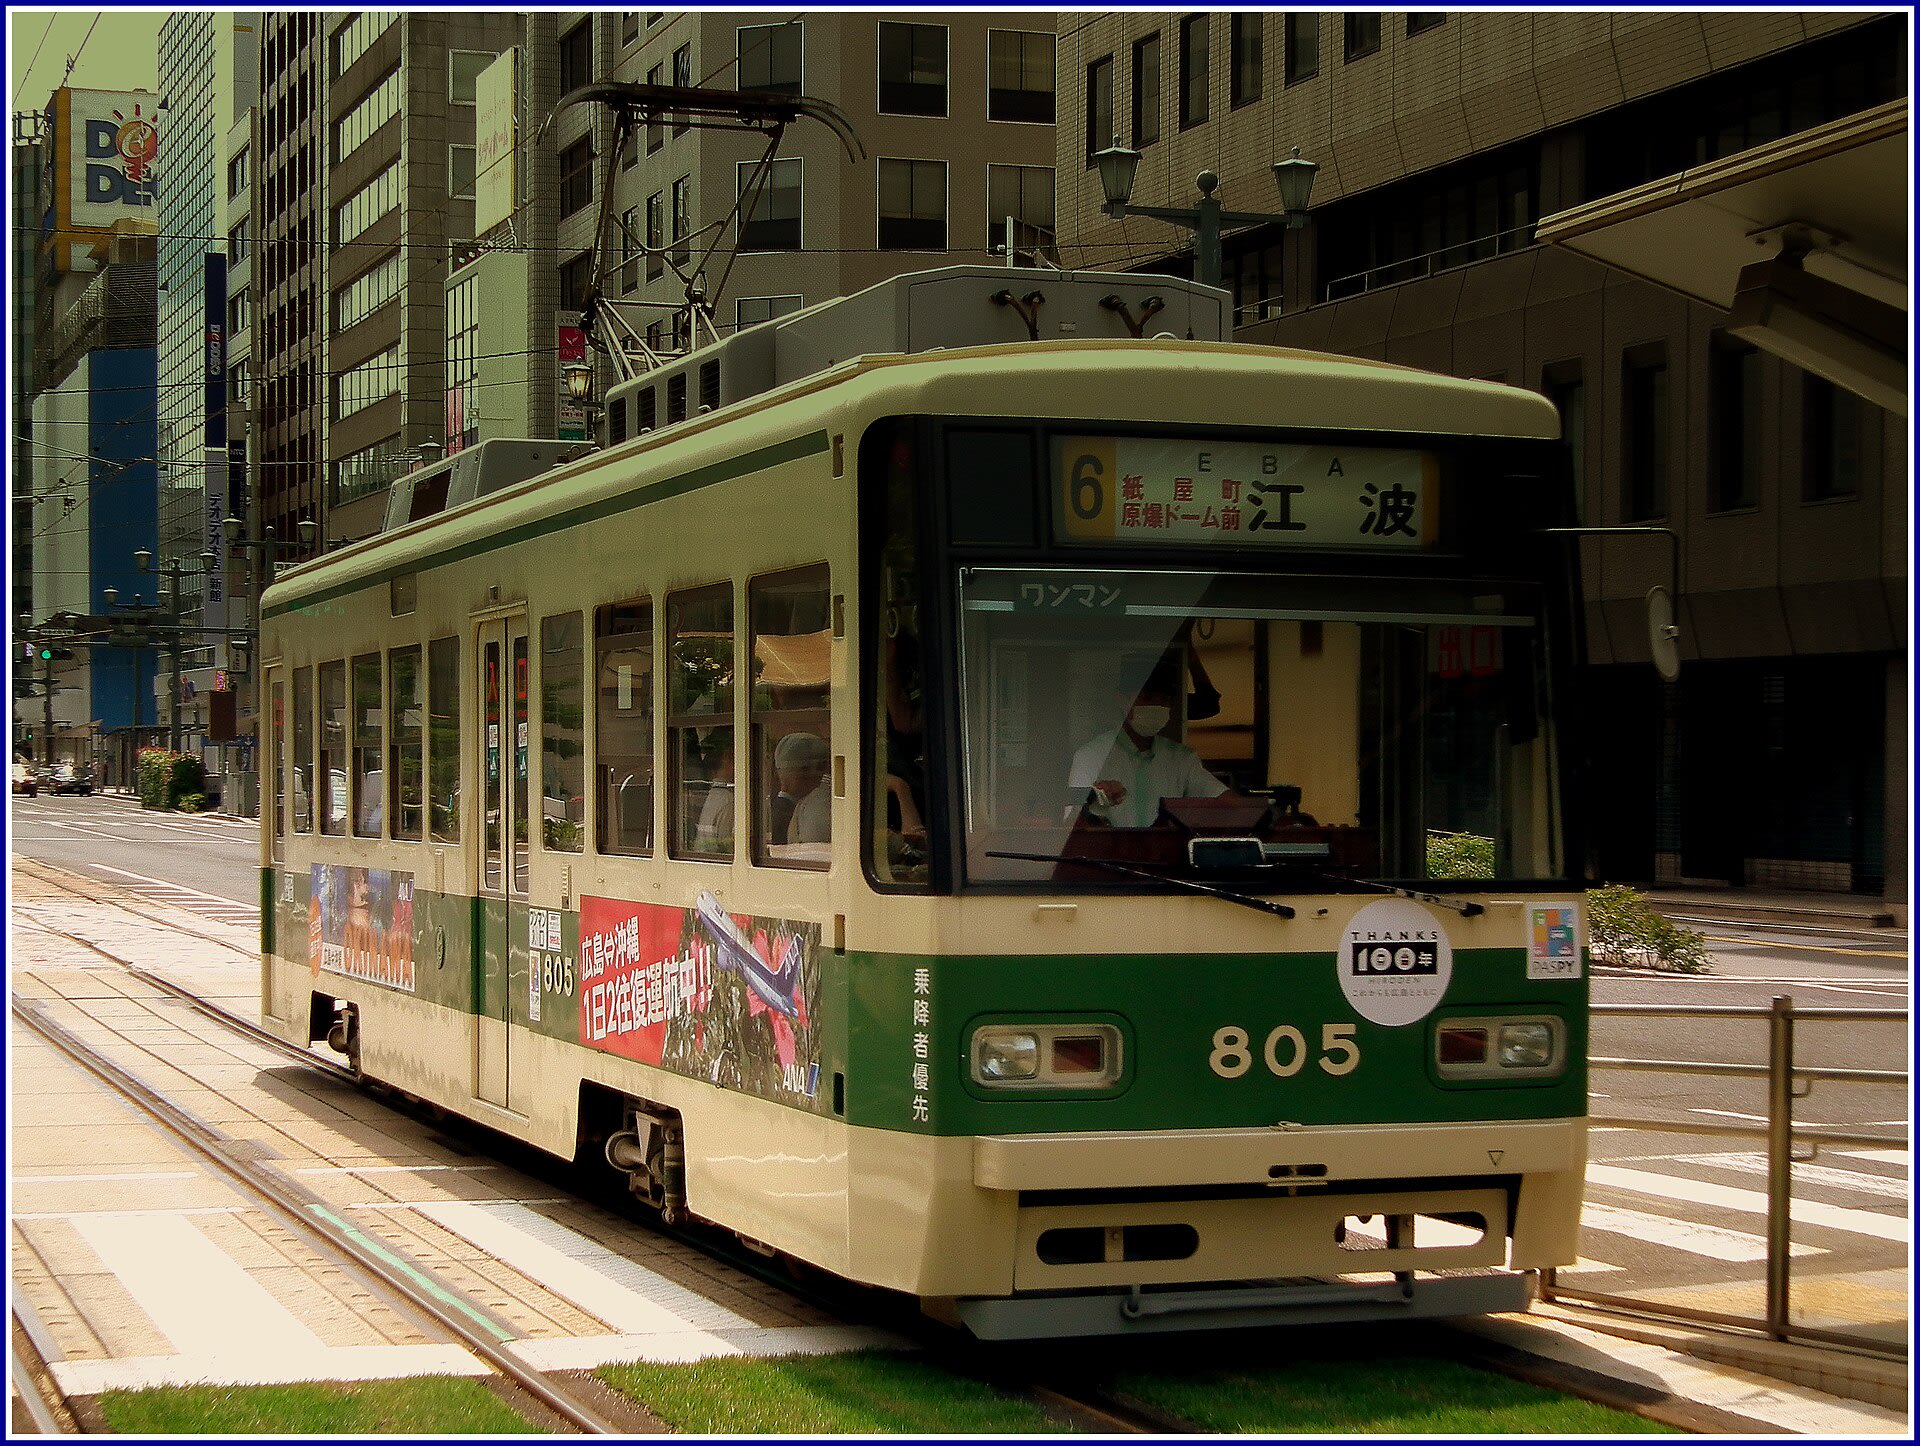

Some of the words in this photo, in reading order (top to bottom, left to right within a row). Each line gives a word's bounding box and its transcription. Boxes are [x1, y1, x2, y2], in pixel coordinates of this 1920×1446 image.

[1069, 454, 1104, 520] 6
[1122, 474, 1242, 503] 紙屋町
[1247, 480, 1417, 538] 江波
[1121, 502, 1241, 533] 原爆ドーム前
[1021, 583, 1121, 607] ワンマン
[1439, 625, 1495, 678] 出口
[1351, 930, 1438, 941] THANKS
[544, 953, 574, 997] 805
[1533, 960, 1575, 974] PASPY
[583, 944, 713, 1041] 1日2往復運航中!!
[913, 967, 931, 1123] 乗降者優先
[1208, 1022, 1361, 1079] 805
[782, 1063, 806, 1094] ANA
